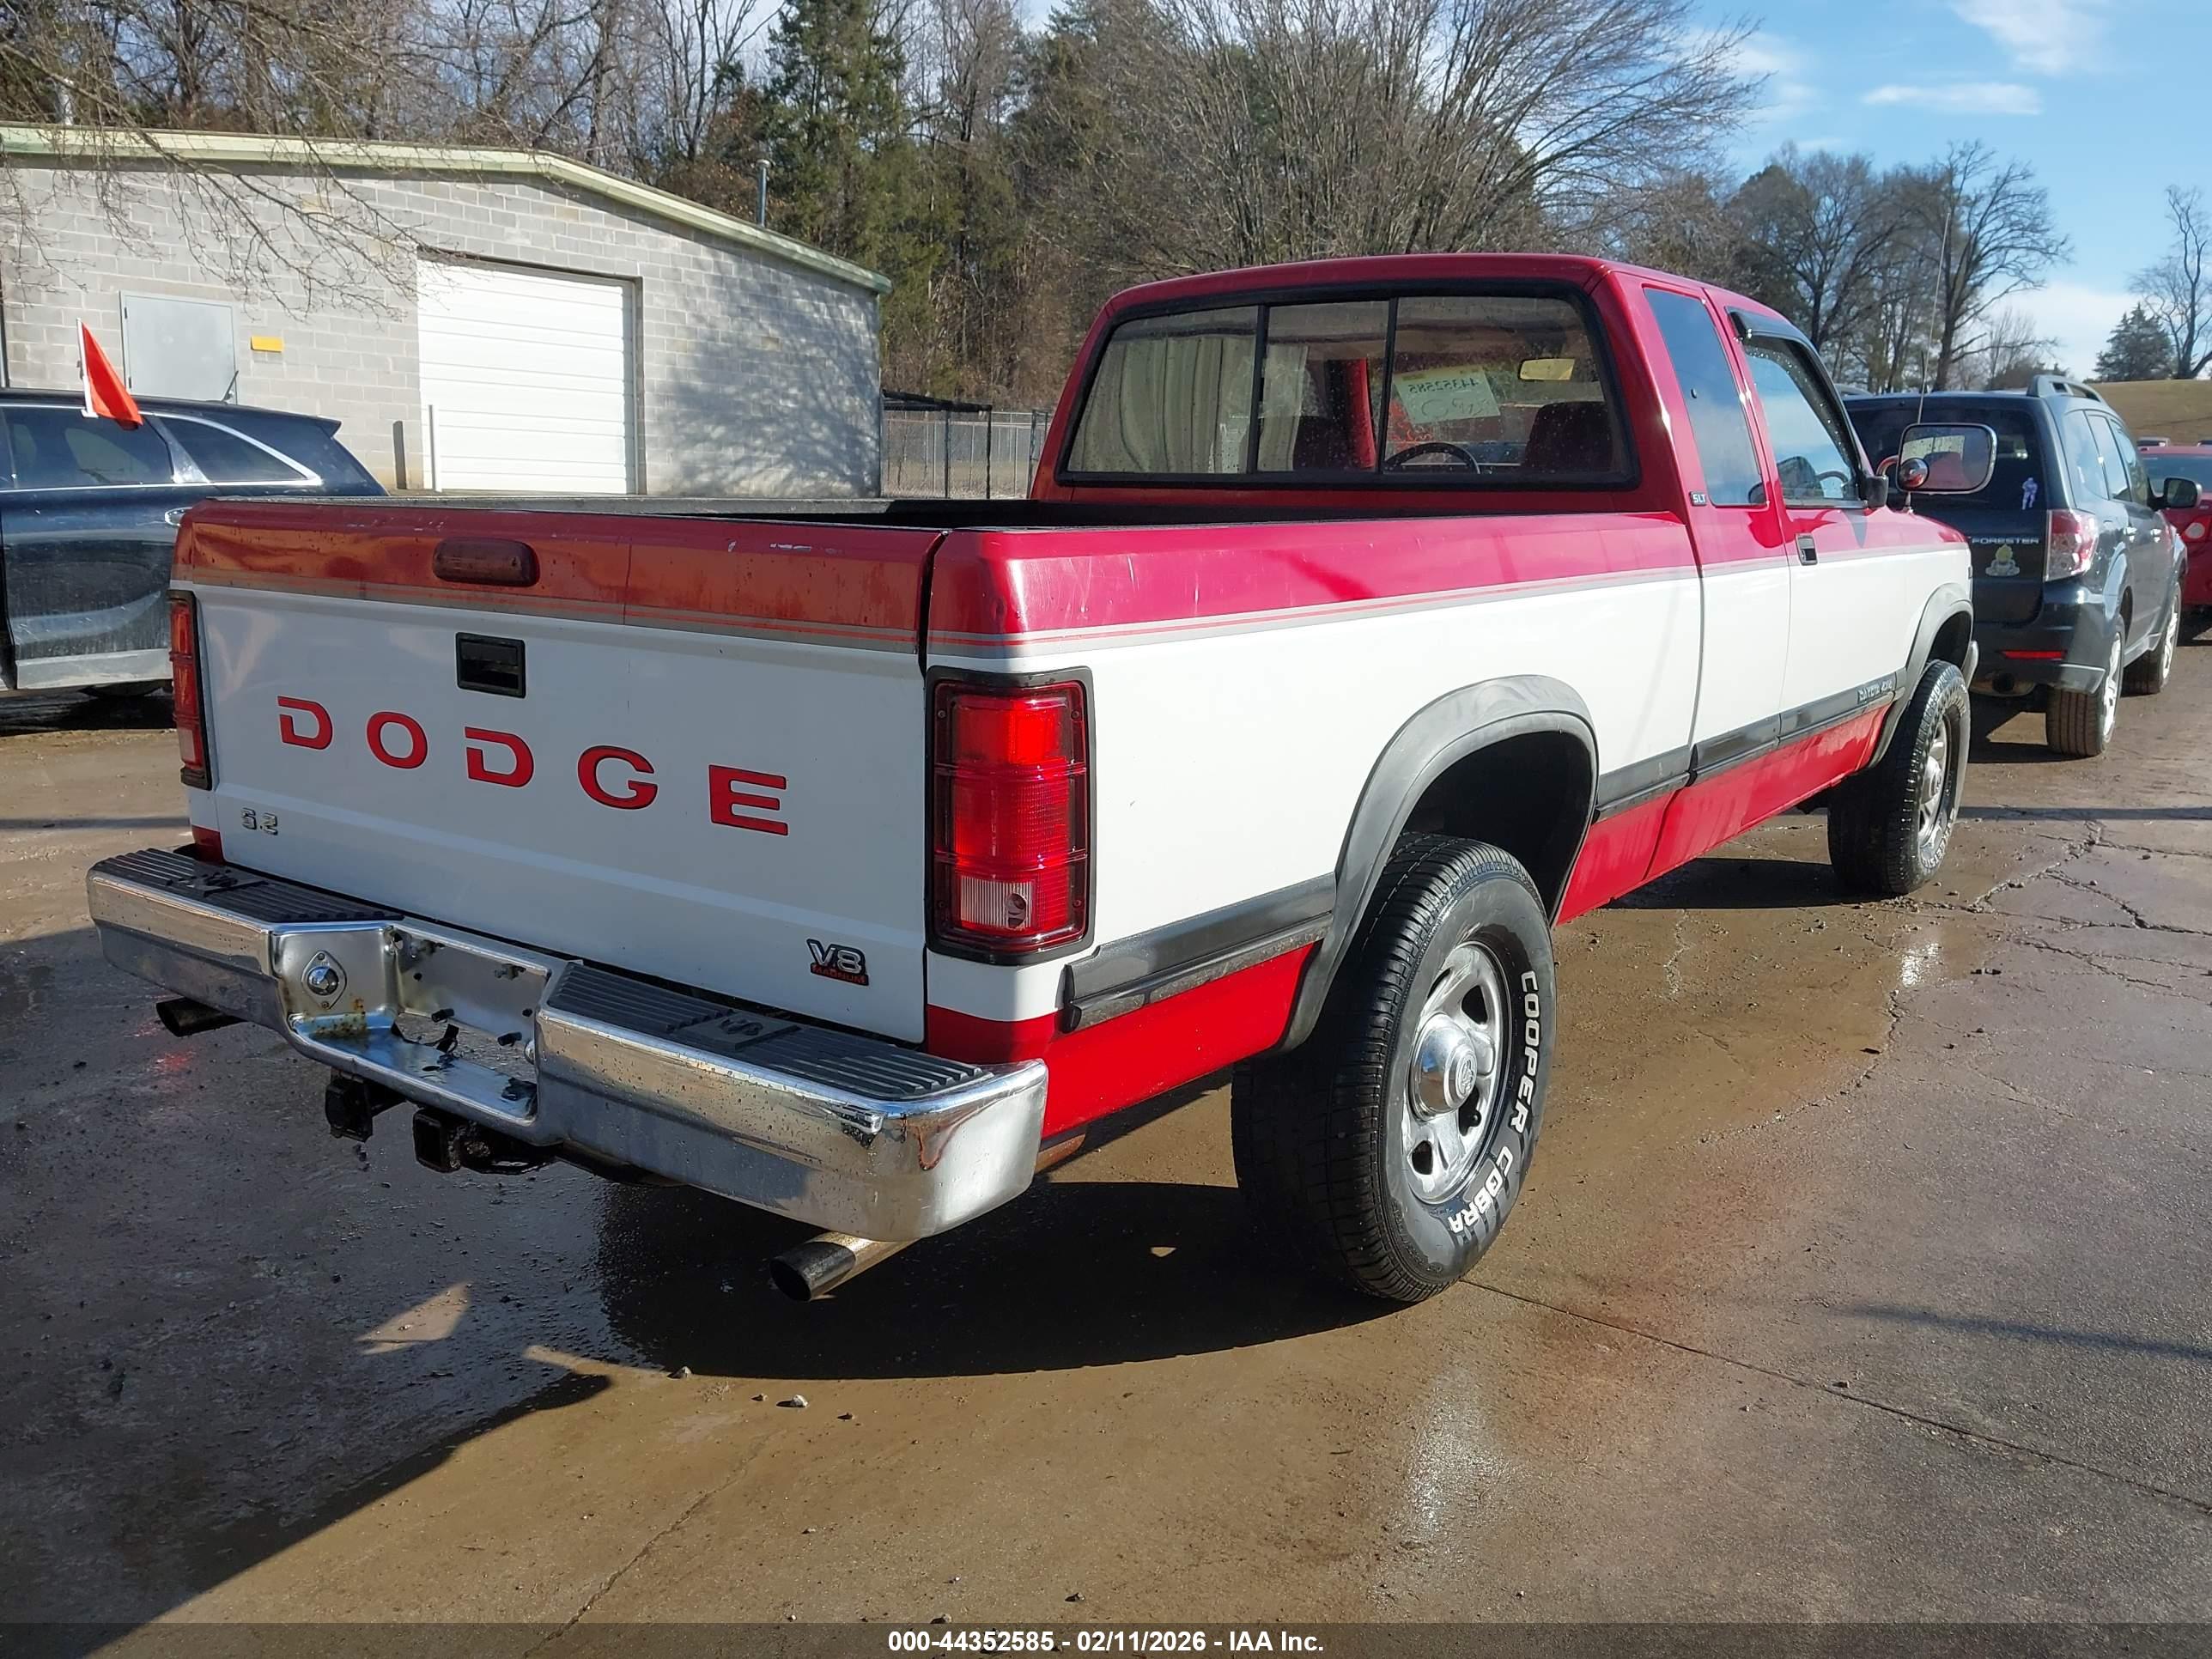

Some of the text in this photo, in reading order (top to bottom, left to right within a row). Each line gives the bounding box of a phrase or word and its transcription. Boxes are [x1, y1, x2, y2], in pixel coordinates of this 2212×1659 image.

[1692, 494, 1706, 503] SLT
[277, 695, 789, 836] DODGE
[807, 939, 866, 975] V8
[1447, 969, 1540, 1233] COOPER COBRA
